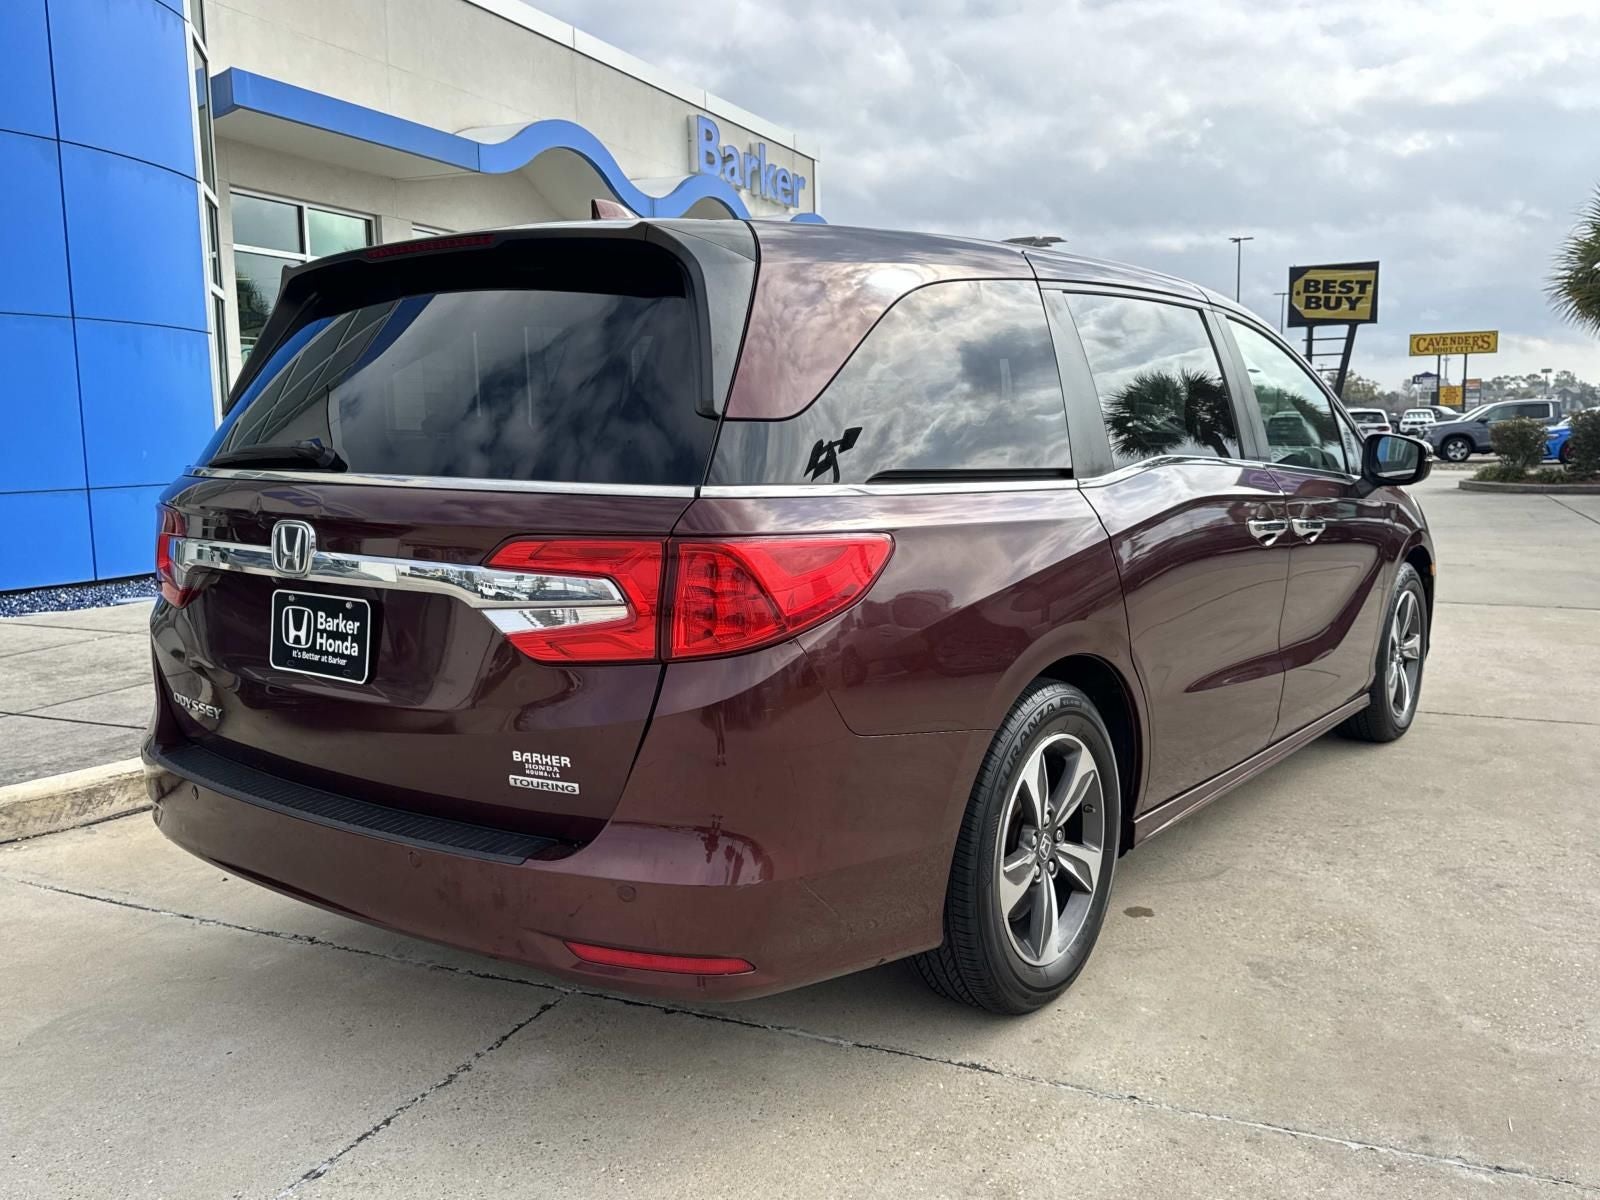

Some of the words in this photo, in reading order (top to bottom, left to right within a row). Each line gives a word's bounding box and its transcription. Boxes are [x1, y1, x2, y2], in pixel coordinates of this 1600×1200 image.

[692, 114, 806, 208] Barker
[1303, 279, 1372, 294] BEST
[1304, 295, 1364, 311] BUY
[1416, 334, 1491, 353] CAVENDER'S
[317, 611, 360, 635] Barker
[316, 631, 359, 656] Honda
[292, 649, 302, 658] It's
[302, 651, 321, 661] Better
[328, 655, 347, 666] Barker
[173, 692, 223, 720] ODYSSEY
[512, 750, 571, 768] BARKER
[525, 763, 560, 773] HONDA
[511, 777, 577, 793] TOURING
